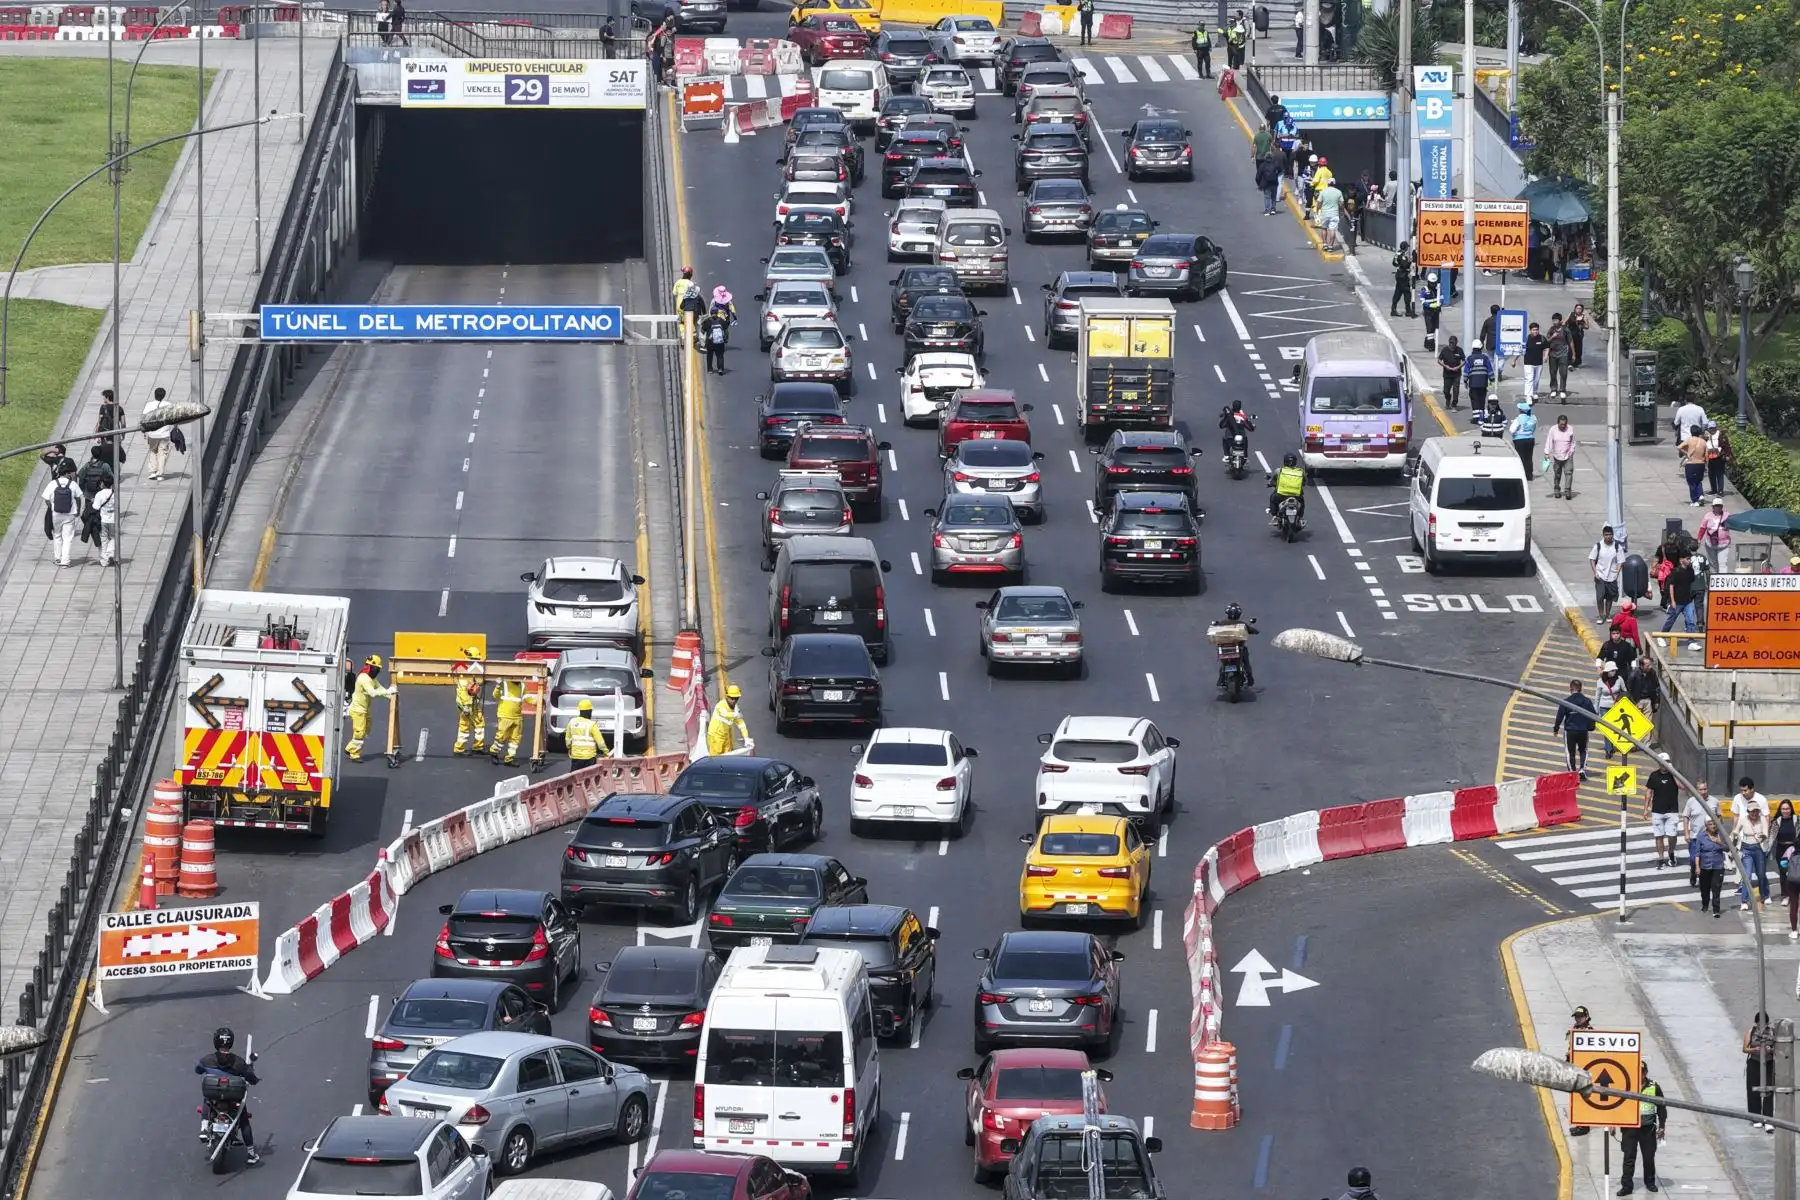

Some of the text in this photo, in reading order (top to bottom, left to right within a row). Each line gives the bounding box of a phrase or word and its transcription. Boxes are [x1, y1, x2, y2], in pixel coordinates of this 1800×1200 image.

[418, 64, 448, 73] LIMA
[469, 62, 583, 73] IMPUESTO VEHICULAR
[608, 70, 639, 83] SAT
[1421, 71, 1447, 83] ATU
[510, 78, 543, 101] 29
[552, 86, 586, 94] DE MAYO
[1426, 97, 1443, 119] B
[1430, 145, 1439, 180] ESTACIÓN
[1440, 146, 1448, 181] CENTRAL
[1423, 232, 1524, 246] CLAUURADA
[1422, 254, 1447, 262] USAR
[1475, 255, 1524, 264] ALTERNAS
[271, 310, 612, 330] TÚNEL DEL METROPOLITANO
[1741, 577, 1768, 588] OBRAS
[1770, 577, 1797, 588] METRO
[1402, 593, 1544, 613] SOLO
[1714, 612, 1790, 622] TRANSPORTE
[1714, 635, 1750, 644] HACIA:
[1712, 650, 1748, 660] PLAZA
[107, 905, 252, 928] CALLE CLAUSURADA
[105, 958, 252, 977] ACCESO SOLO PROPIETARIOS
[1575, 1036, 1637, 1047] DESVIO
